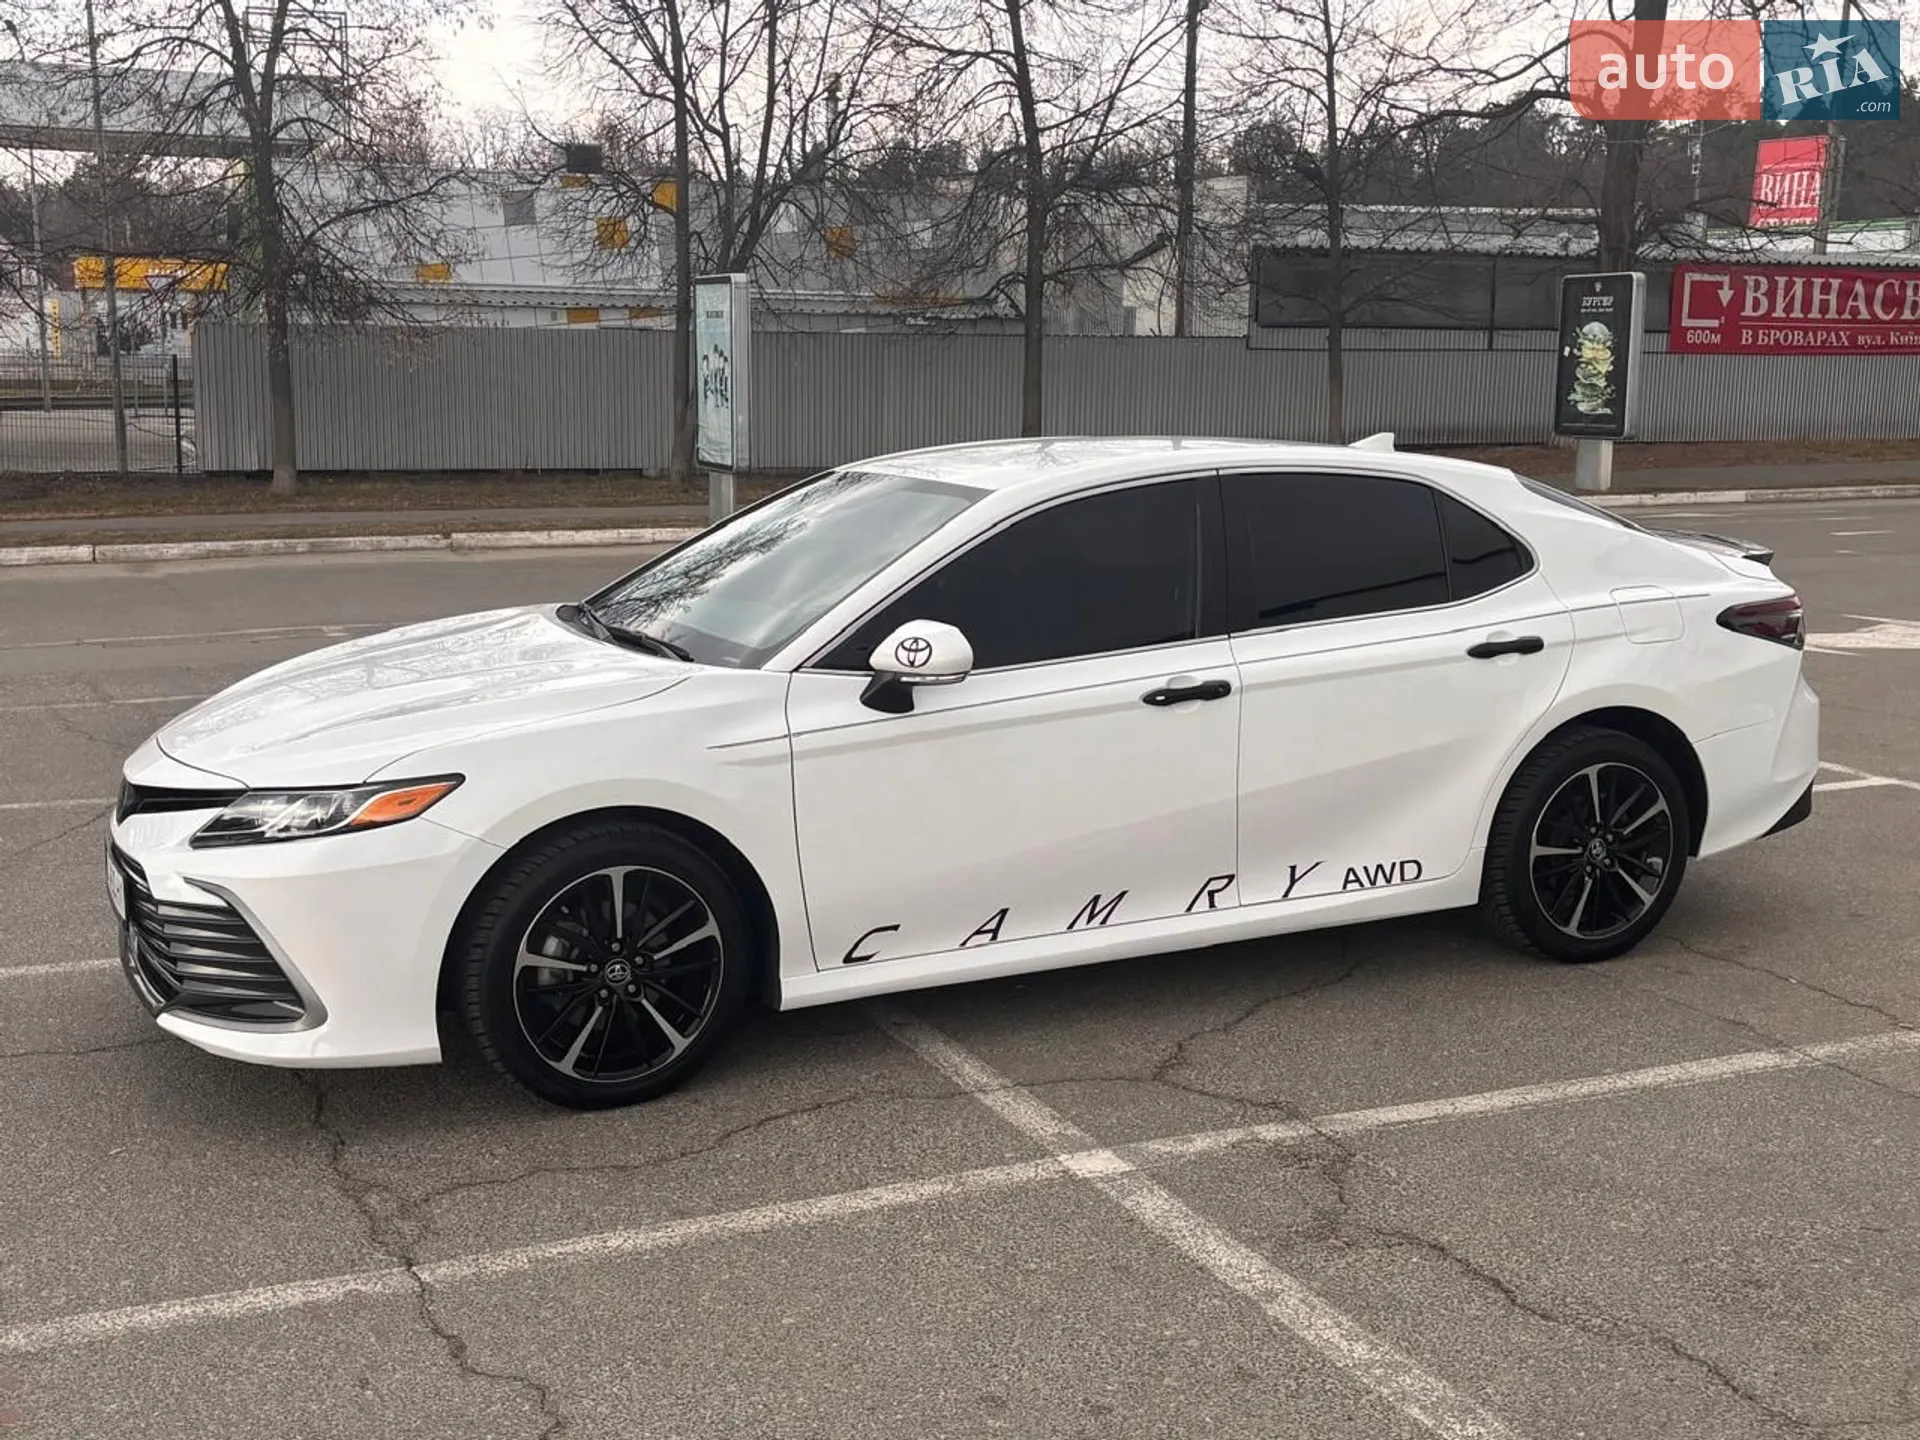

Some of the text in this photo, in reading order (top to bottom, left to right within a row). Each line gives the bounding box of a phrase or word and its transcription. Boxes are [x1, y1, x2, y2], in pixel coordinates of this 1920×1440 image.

[1686, 329, 1721, 344] 600м
[1740, 329, 1753, 345] В
[1757, 329, 1850, 346] БРОВАРАХ
[1857, 335, 1886, 349] вул.
[842, 858, 1424, 964] CAMRY AWD
